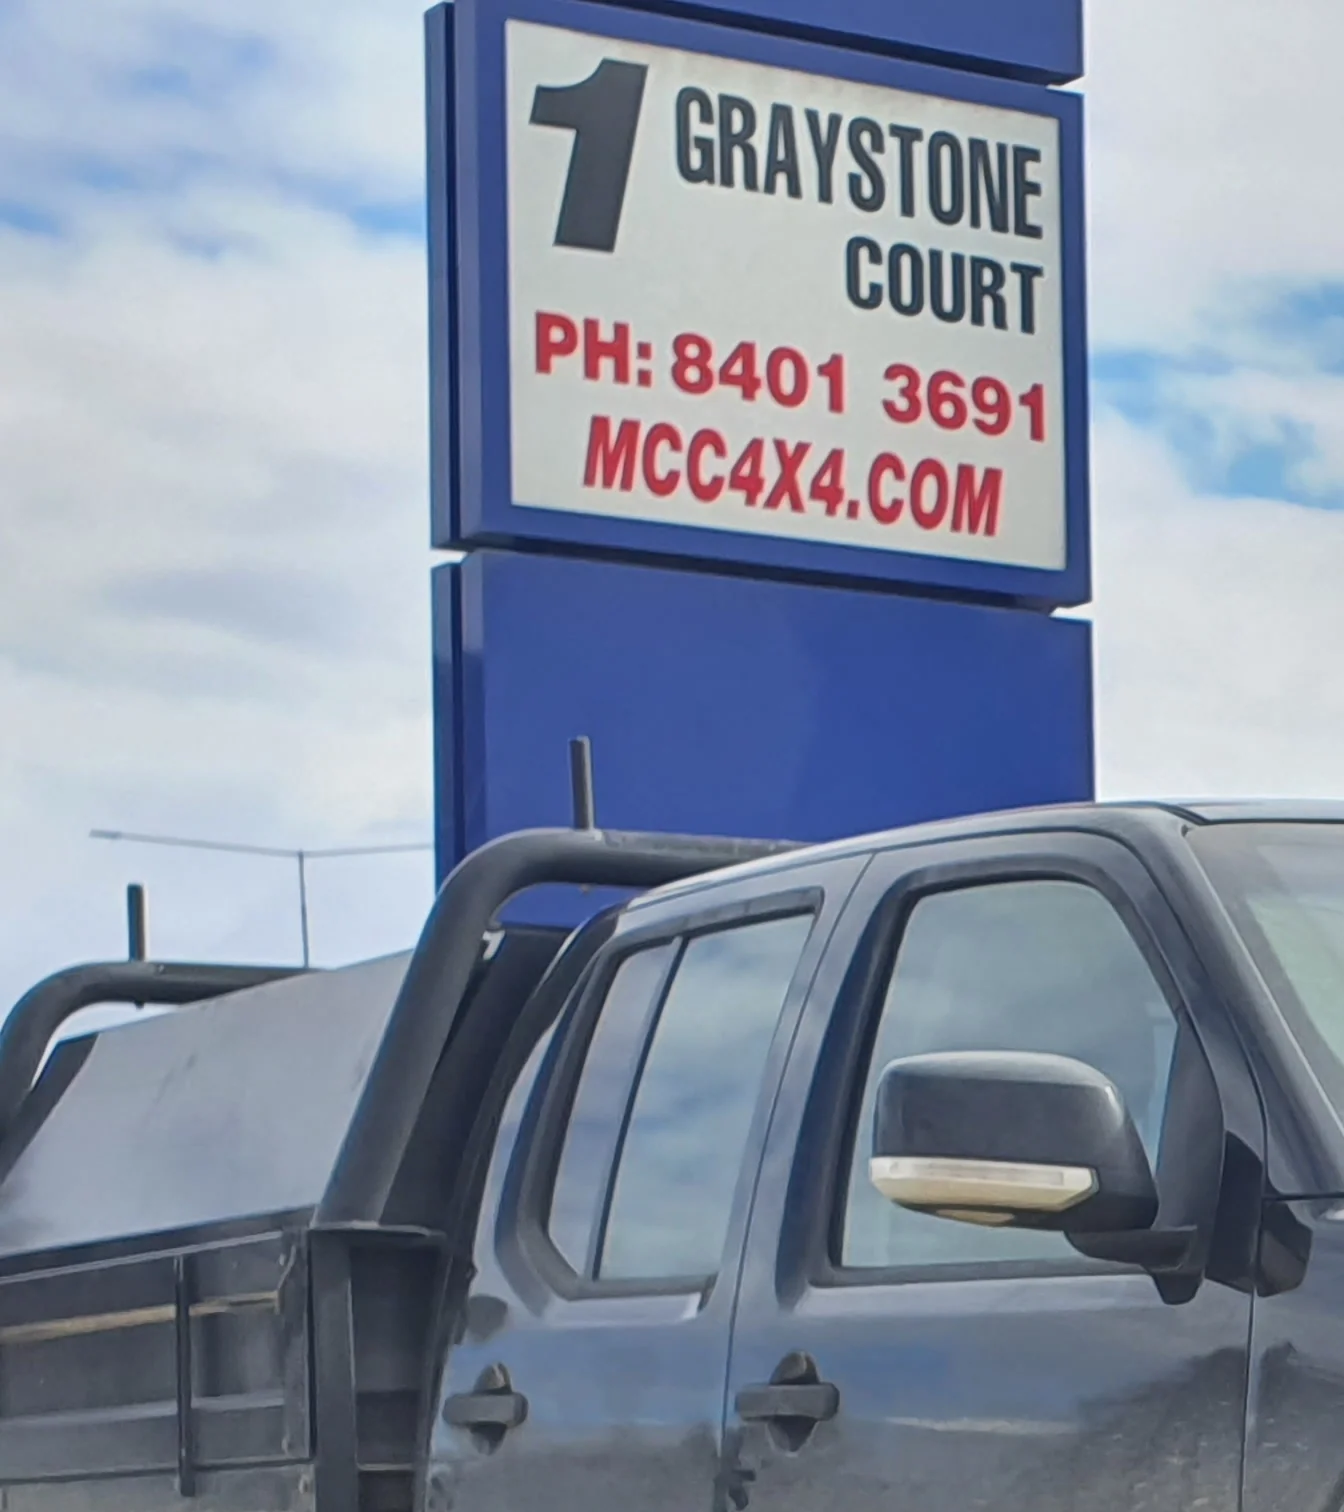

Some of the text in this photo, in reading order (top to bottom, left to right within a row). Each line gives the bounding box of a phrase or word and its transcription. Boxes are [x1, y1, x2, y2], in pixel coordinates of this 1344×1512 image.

[528, 57, 1043, 253] 1 GRAYSTONE
[845, 236, 1044, 335] COURT
[534, 309, 1046, 442] PH: 8401 3691
[582, 414, 1003, 536] MCC4X4.COM
